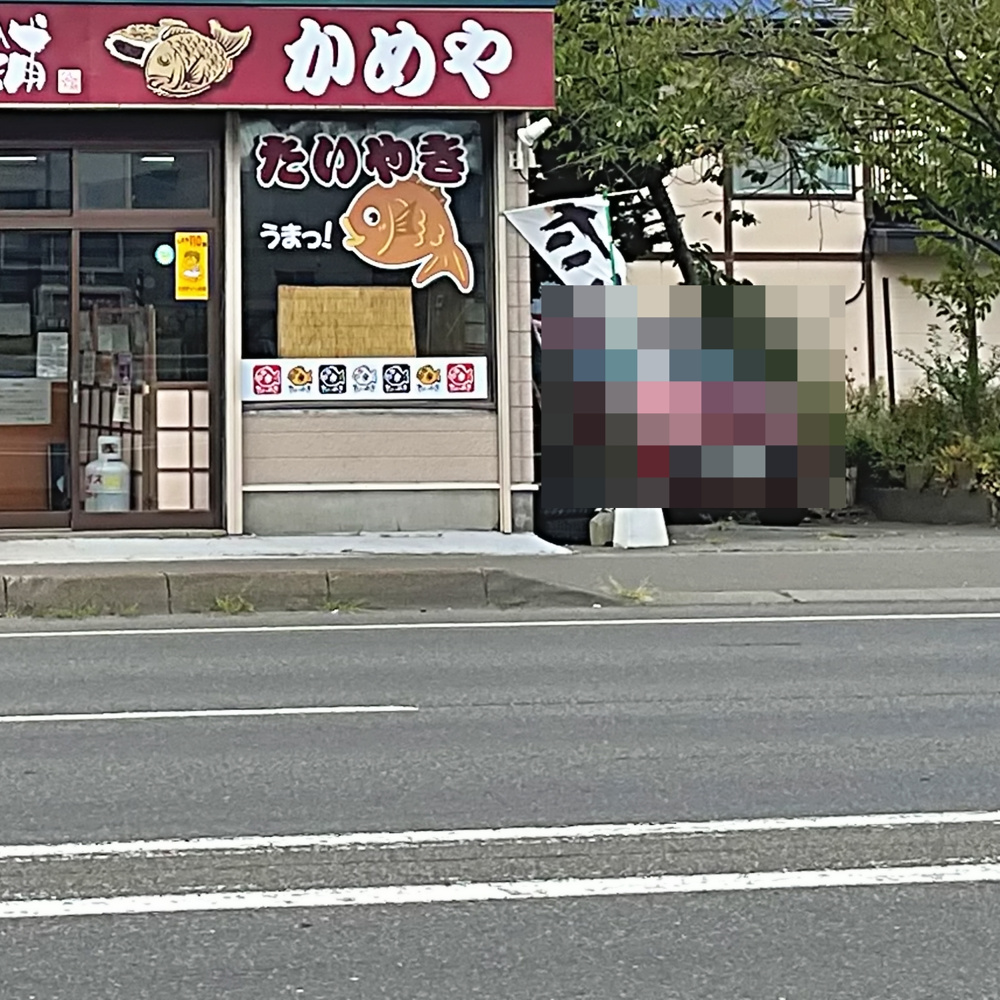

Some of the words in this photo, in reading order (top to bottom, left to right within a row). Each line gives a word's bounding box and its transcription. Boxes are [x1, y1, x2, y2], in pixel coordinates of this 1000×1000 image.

[283, 16, 514, 100] かめや
[255, 131, 469, 189] たいやき
